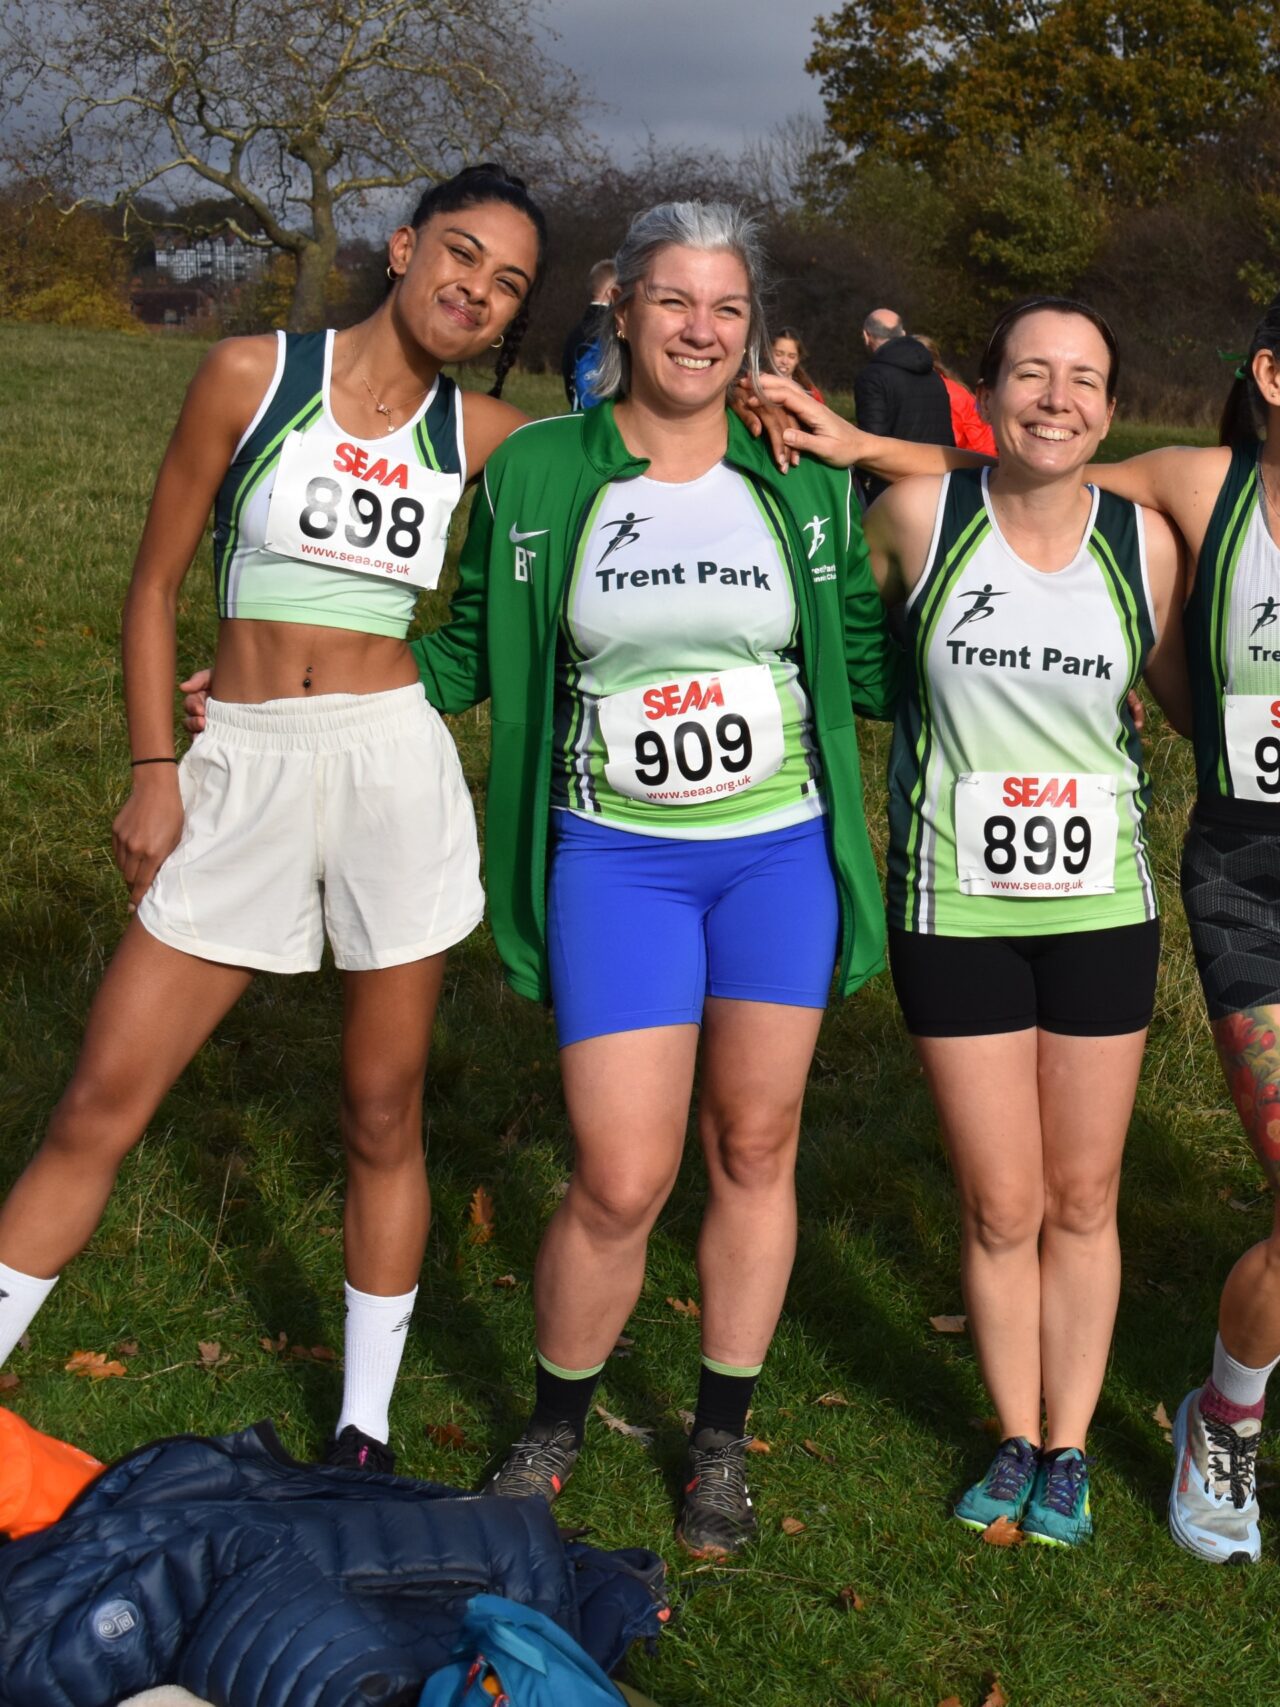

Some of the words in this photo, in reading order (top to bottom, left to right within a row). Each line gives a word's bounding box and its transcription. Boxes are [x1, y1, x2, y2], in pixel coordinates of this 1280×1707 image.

[333, 442, 409, 489] SEAA
[299, 476, 425, 559] 898
[301, 543, 410, 576] www.seaa.org.uk
[595, 562, 685, 592] Trent
[697, 561, 771, 591] Park
[946, 640, 1031, 670] Trent
[1042, 647, 1115, 680] Park
[642, 677, 725, 720] SEAA
[634, 713, 753, 786] 909
[646, 775, 752, 800] www.seaa.org.uk
[1002, 776, 1077, 808] SEAA
[983, 815, 1092, 875] 899
[991, 878, 1084, 893] www.seaa.org.uk
